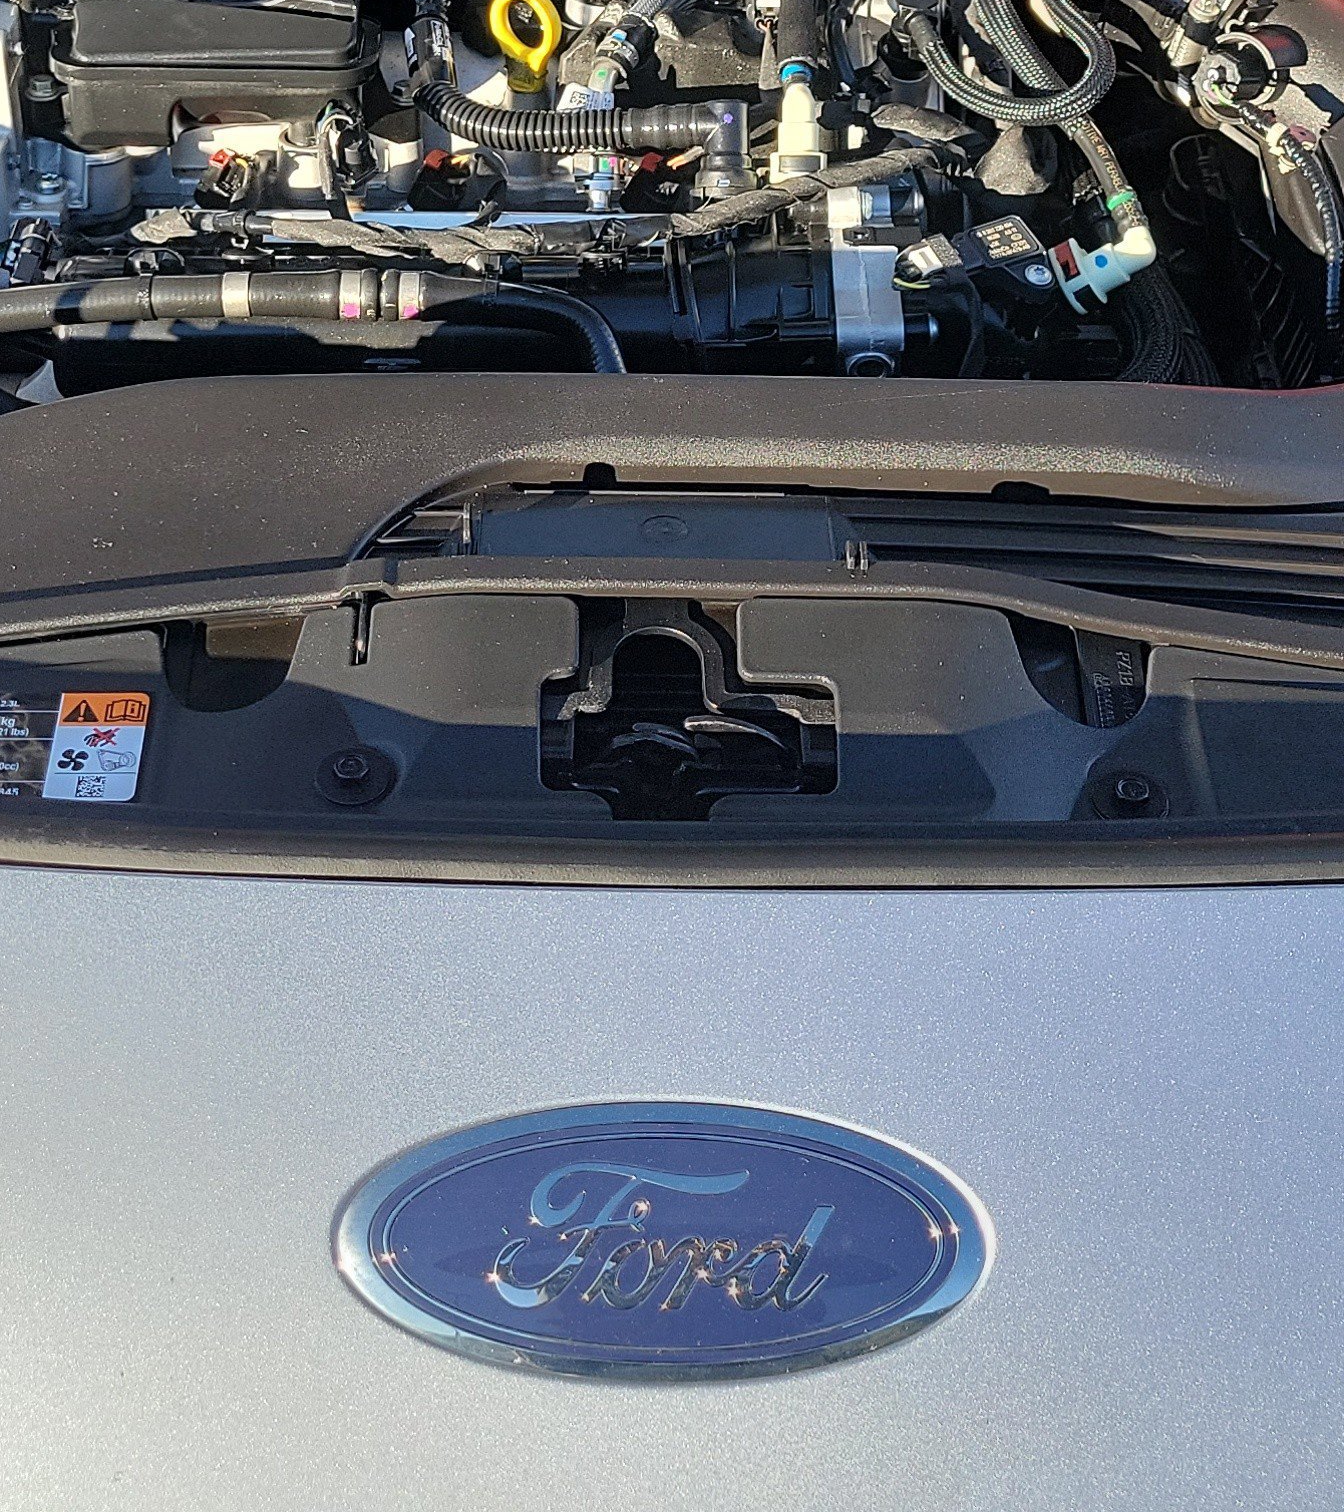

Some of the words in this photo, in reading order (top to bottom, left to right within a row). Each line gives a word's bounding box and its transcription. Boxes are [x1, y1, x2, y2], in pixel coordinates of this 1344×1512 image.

[0, 699, 21, 708] 2.3L
[0, 716, 16, 728] kg
[10, 727, 30, 738] lbs)
[494, 1161, 836, 1312] Ford
